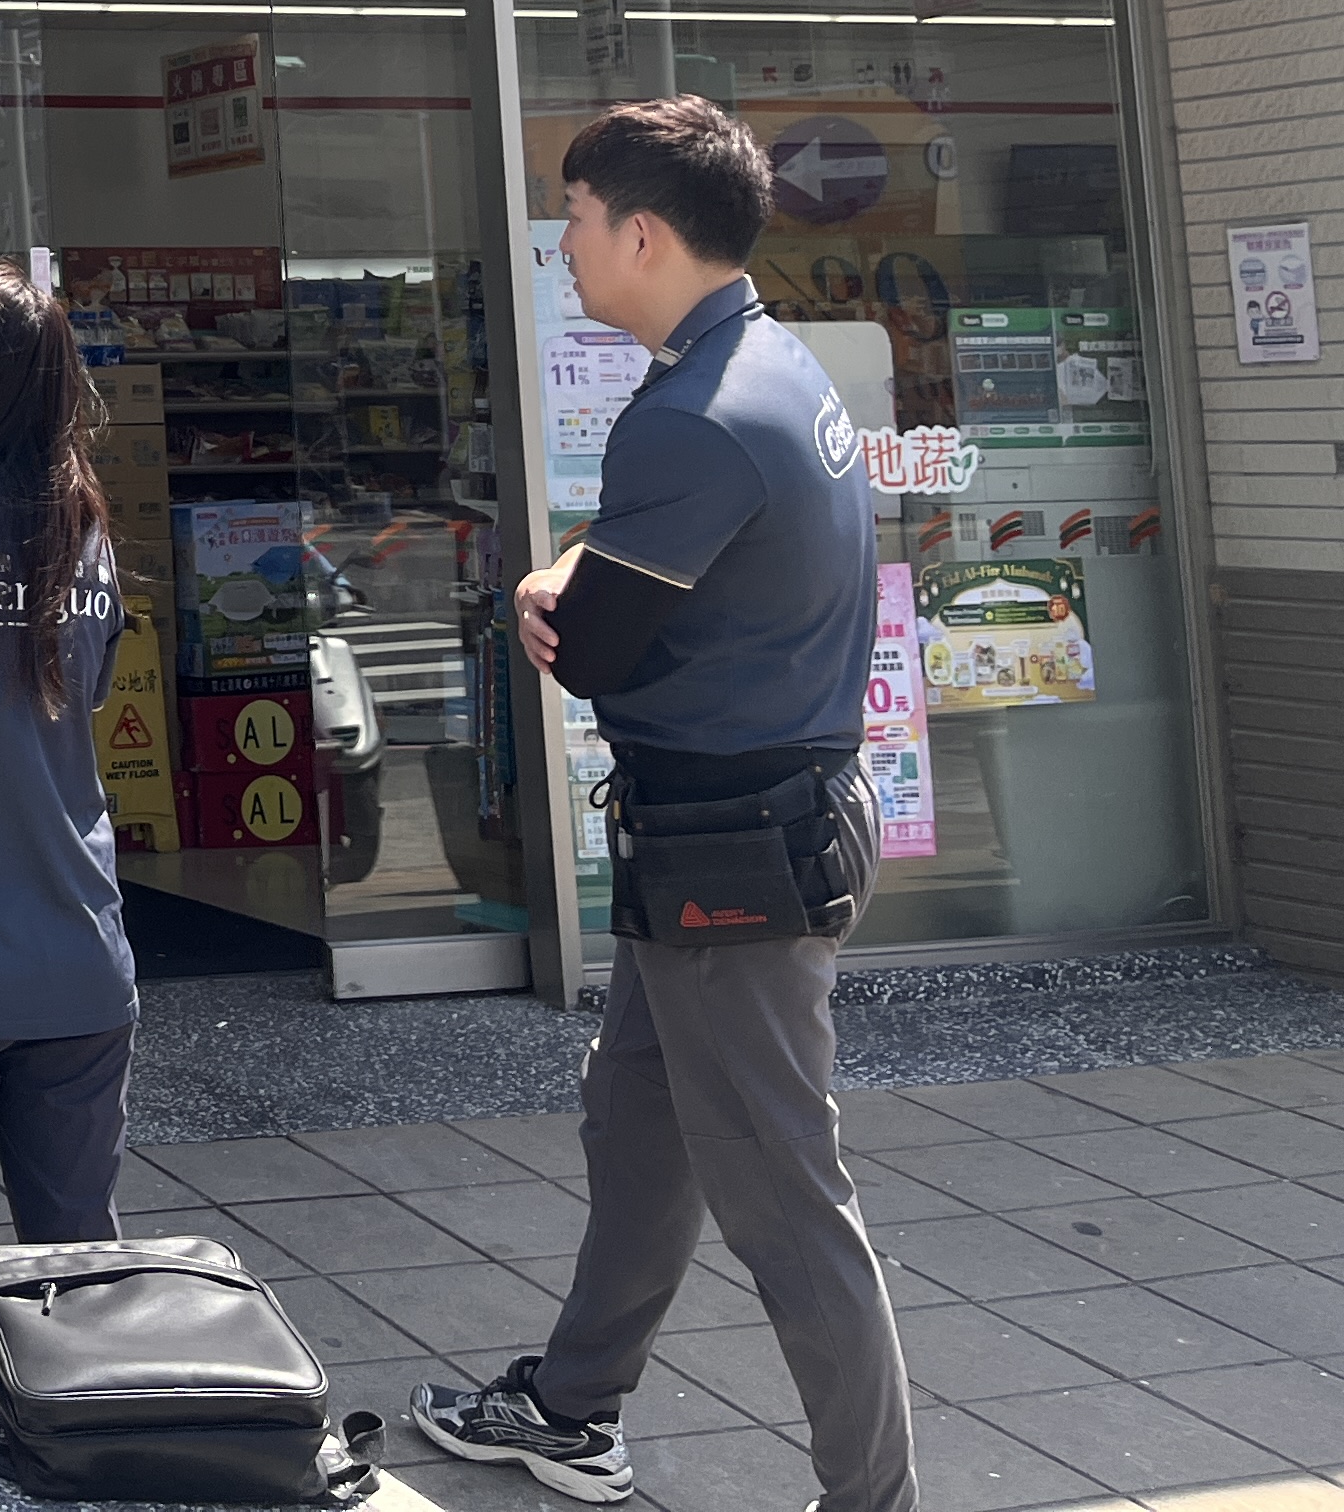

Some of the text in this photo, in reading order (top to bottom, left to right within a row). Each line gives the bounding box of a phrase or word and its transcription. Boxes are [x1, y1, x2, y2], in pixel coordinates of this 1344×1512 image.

[111, 759, 154, 770] CAUTION
[105, 769, 160, 780] WET FLOOR
